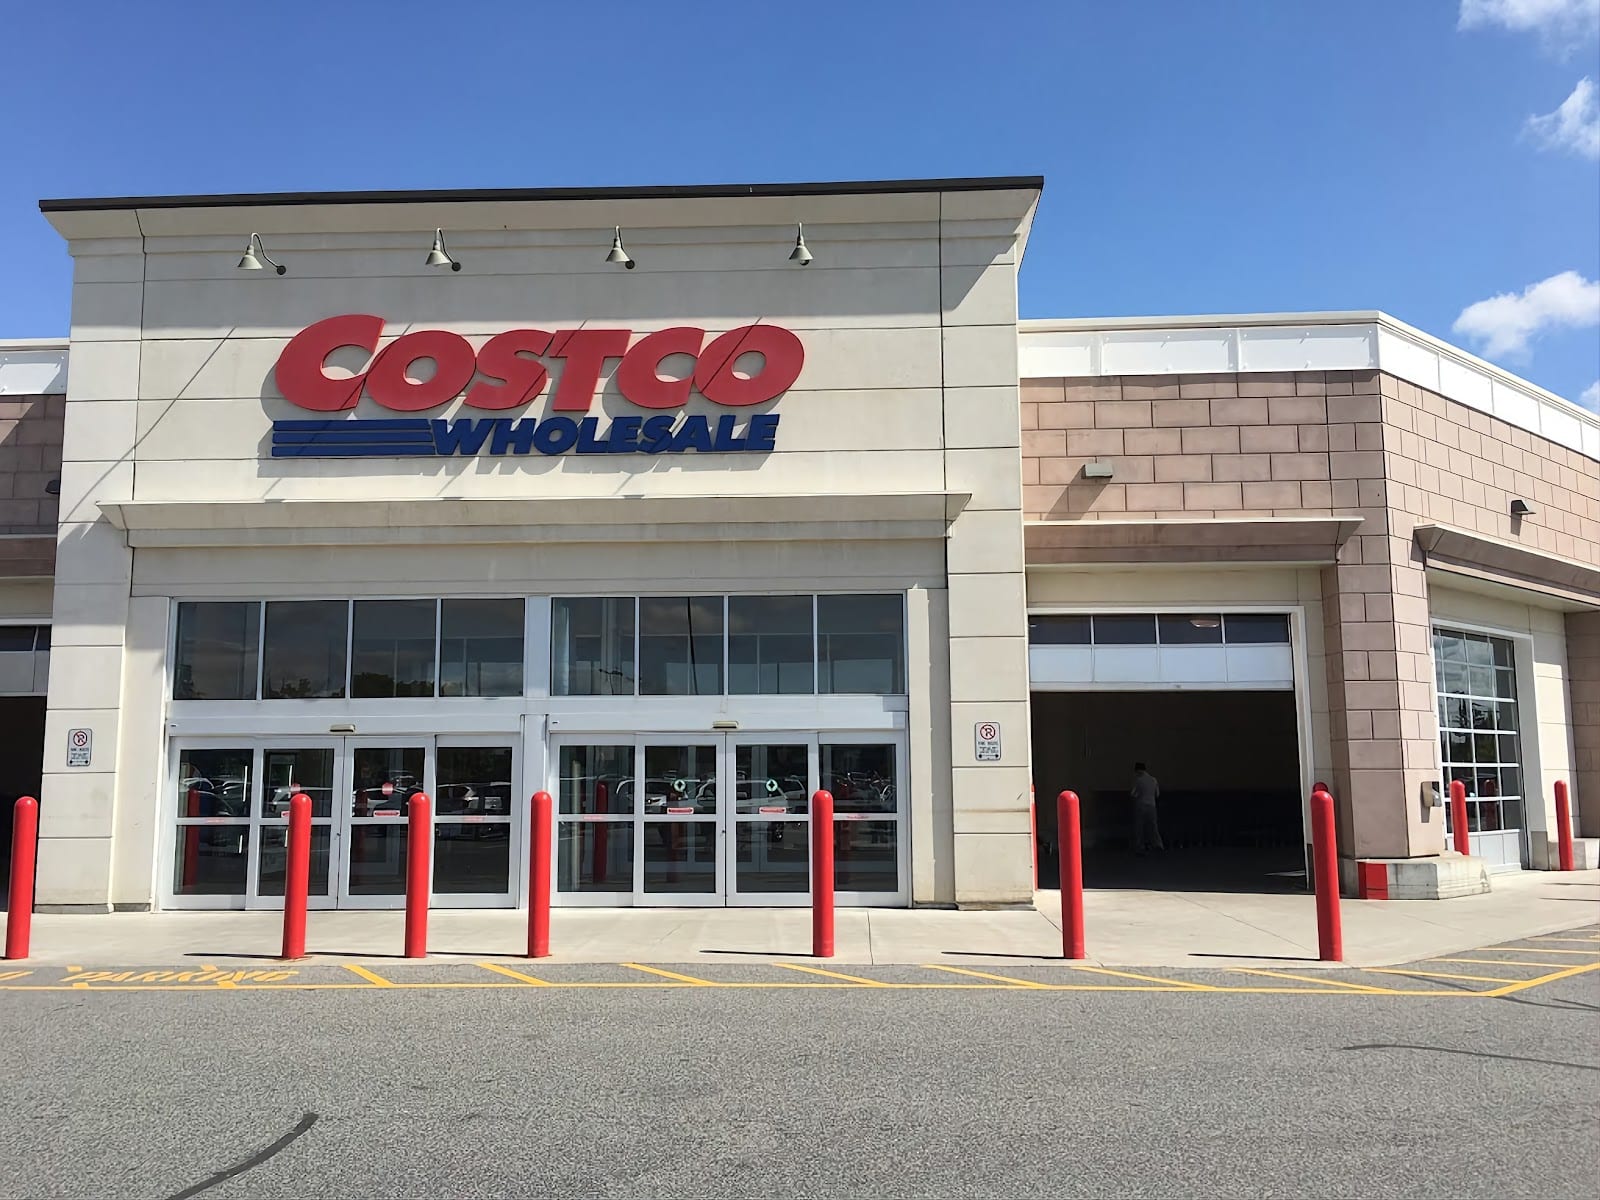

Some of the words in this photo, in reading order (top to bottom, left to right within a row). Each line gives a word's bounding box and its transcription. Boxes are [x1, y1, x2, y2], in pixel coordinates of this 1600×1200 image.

[275, 314, 804, 411] COSTCO
[431, 414, 780, 455] WHOLESALE
[60, 971, 299, 982] PARKING
